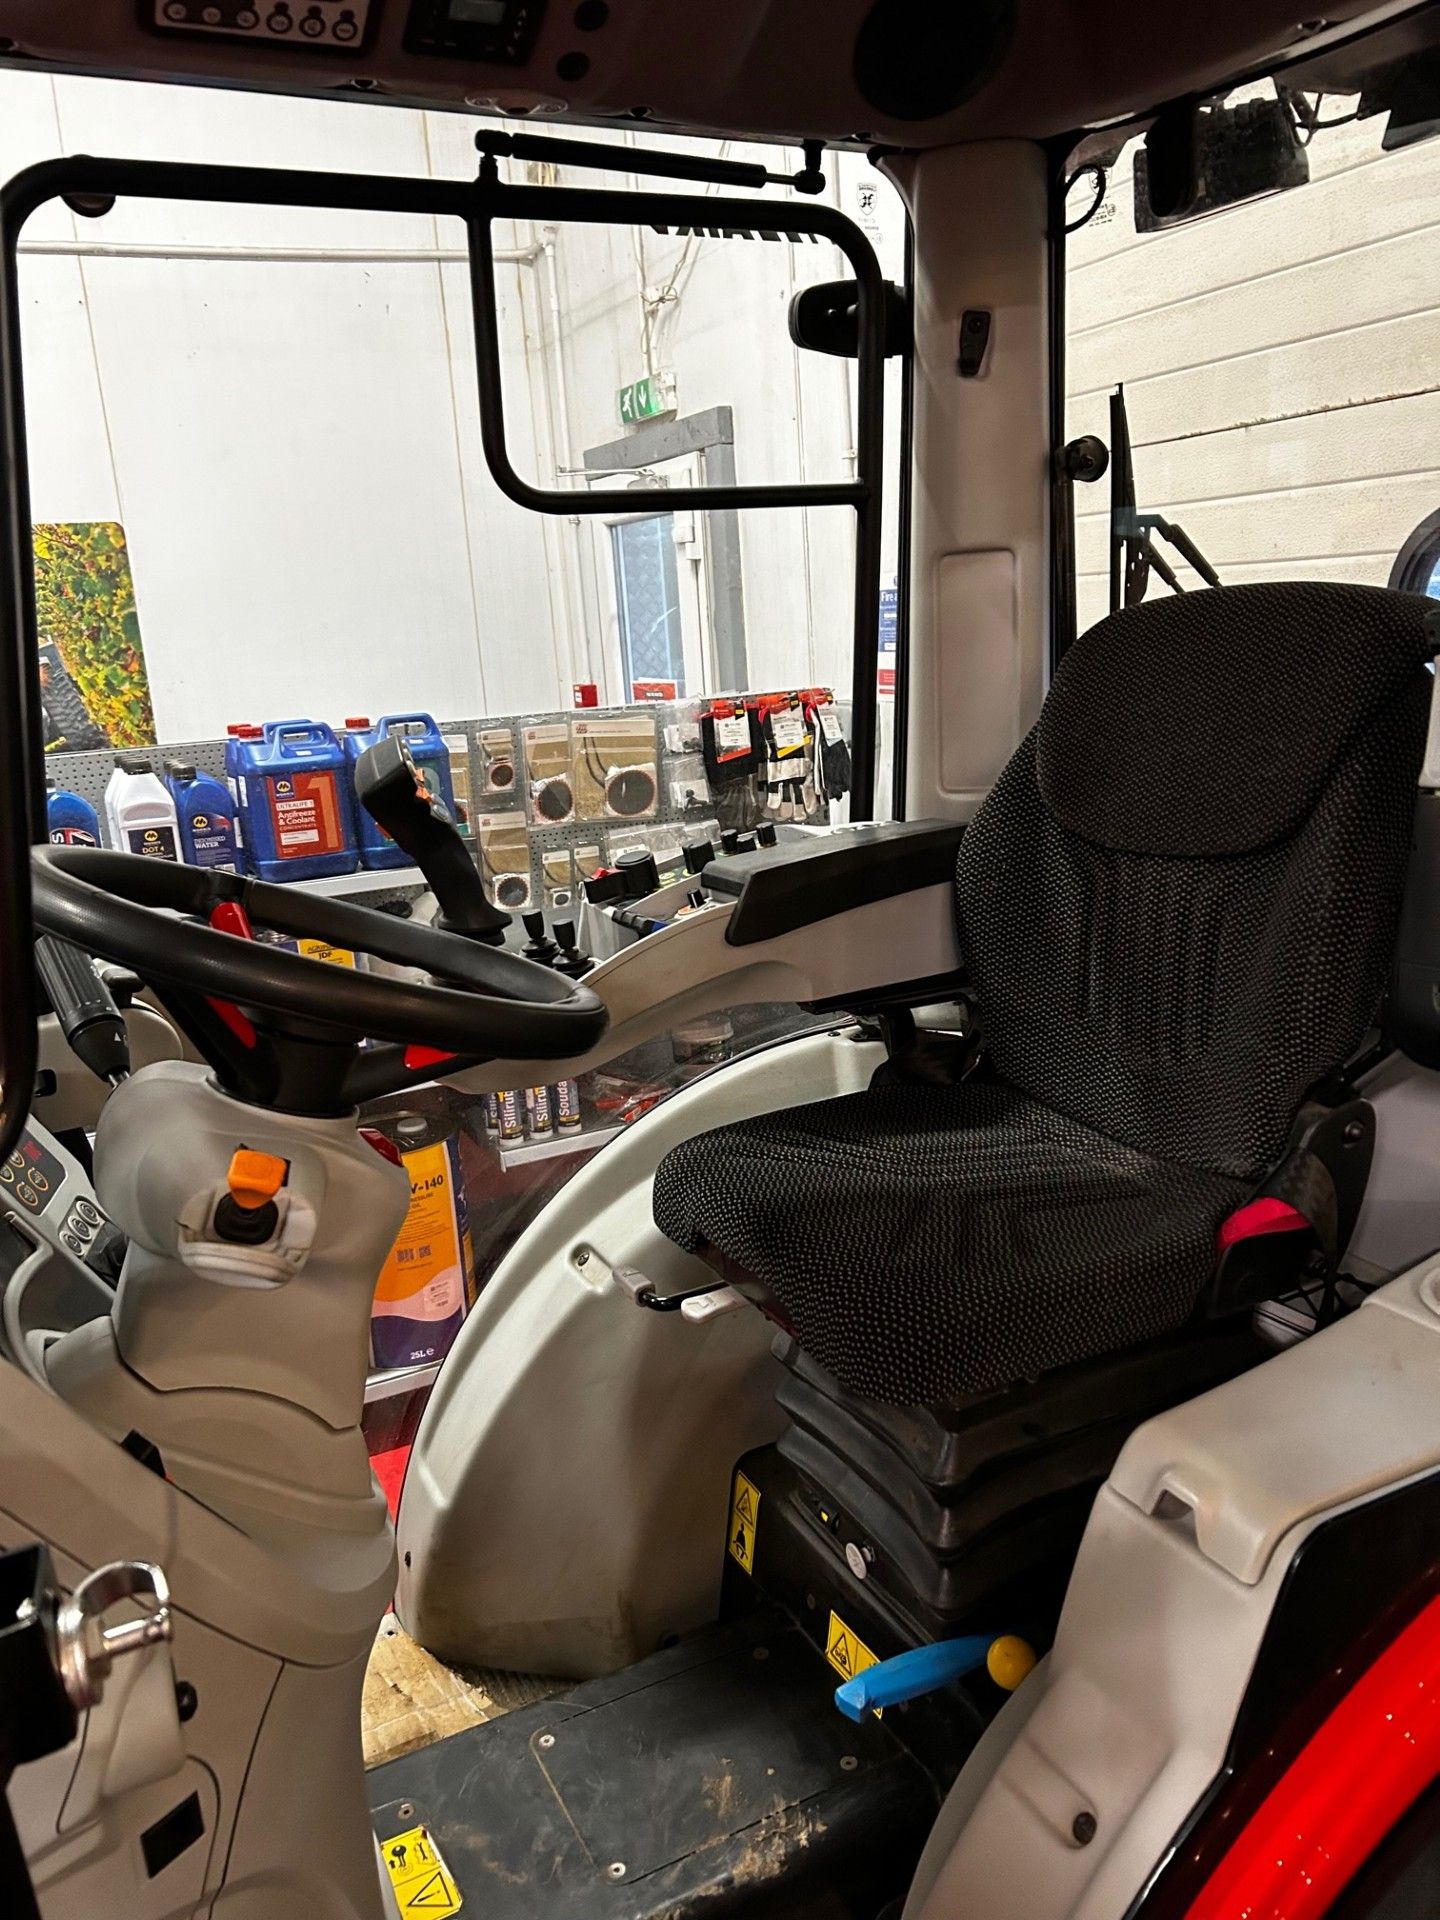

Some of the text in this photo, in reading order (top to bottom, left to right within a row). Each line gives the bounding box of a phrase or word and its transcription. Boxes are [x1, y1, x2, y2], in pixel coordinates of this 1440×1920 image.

[278, 810, 316, 820] Antifreeze
[286, 816, 316, 825] Coolant
[142, 846, 158, 854] DOT
[194, 841, 220, 849] WATER
[557, 1081, 570, 1116] Souda
[535, 1086, 549, 1122] Siliru
[410, 1349, 426, 1360] 25L
